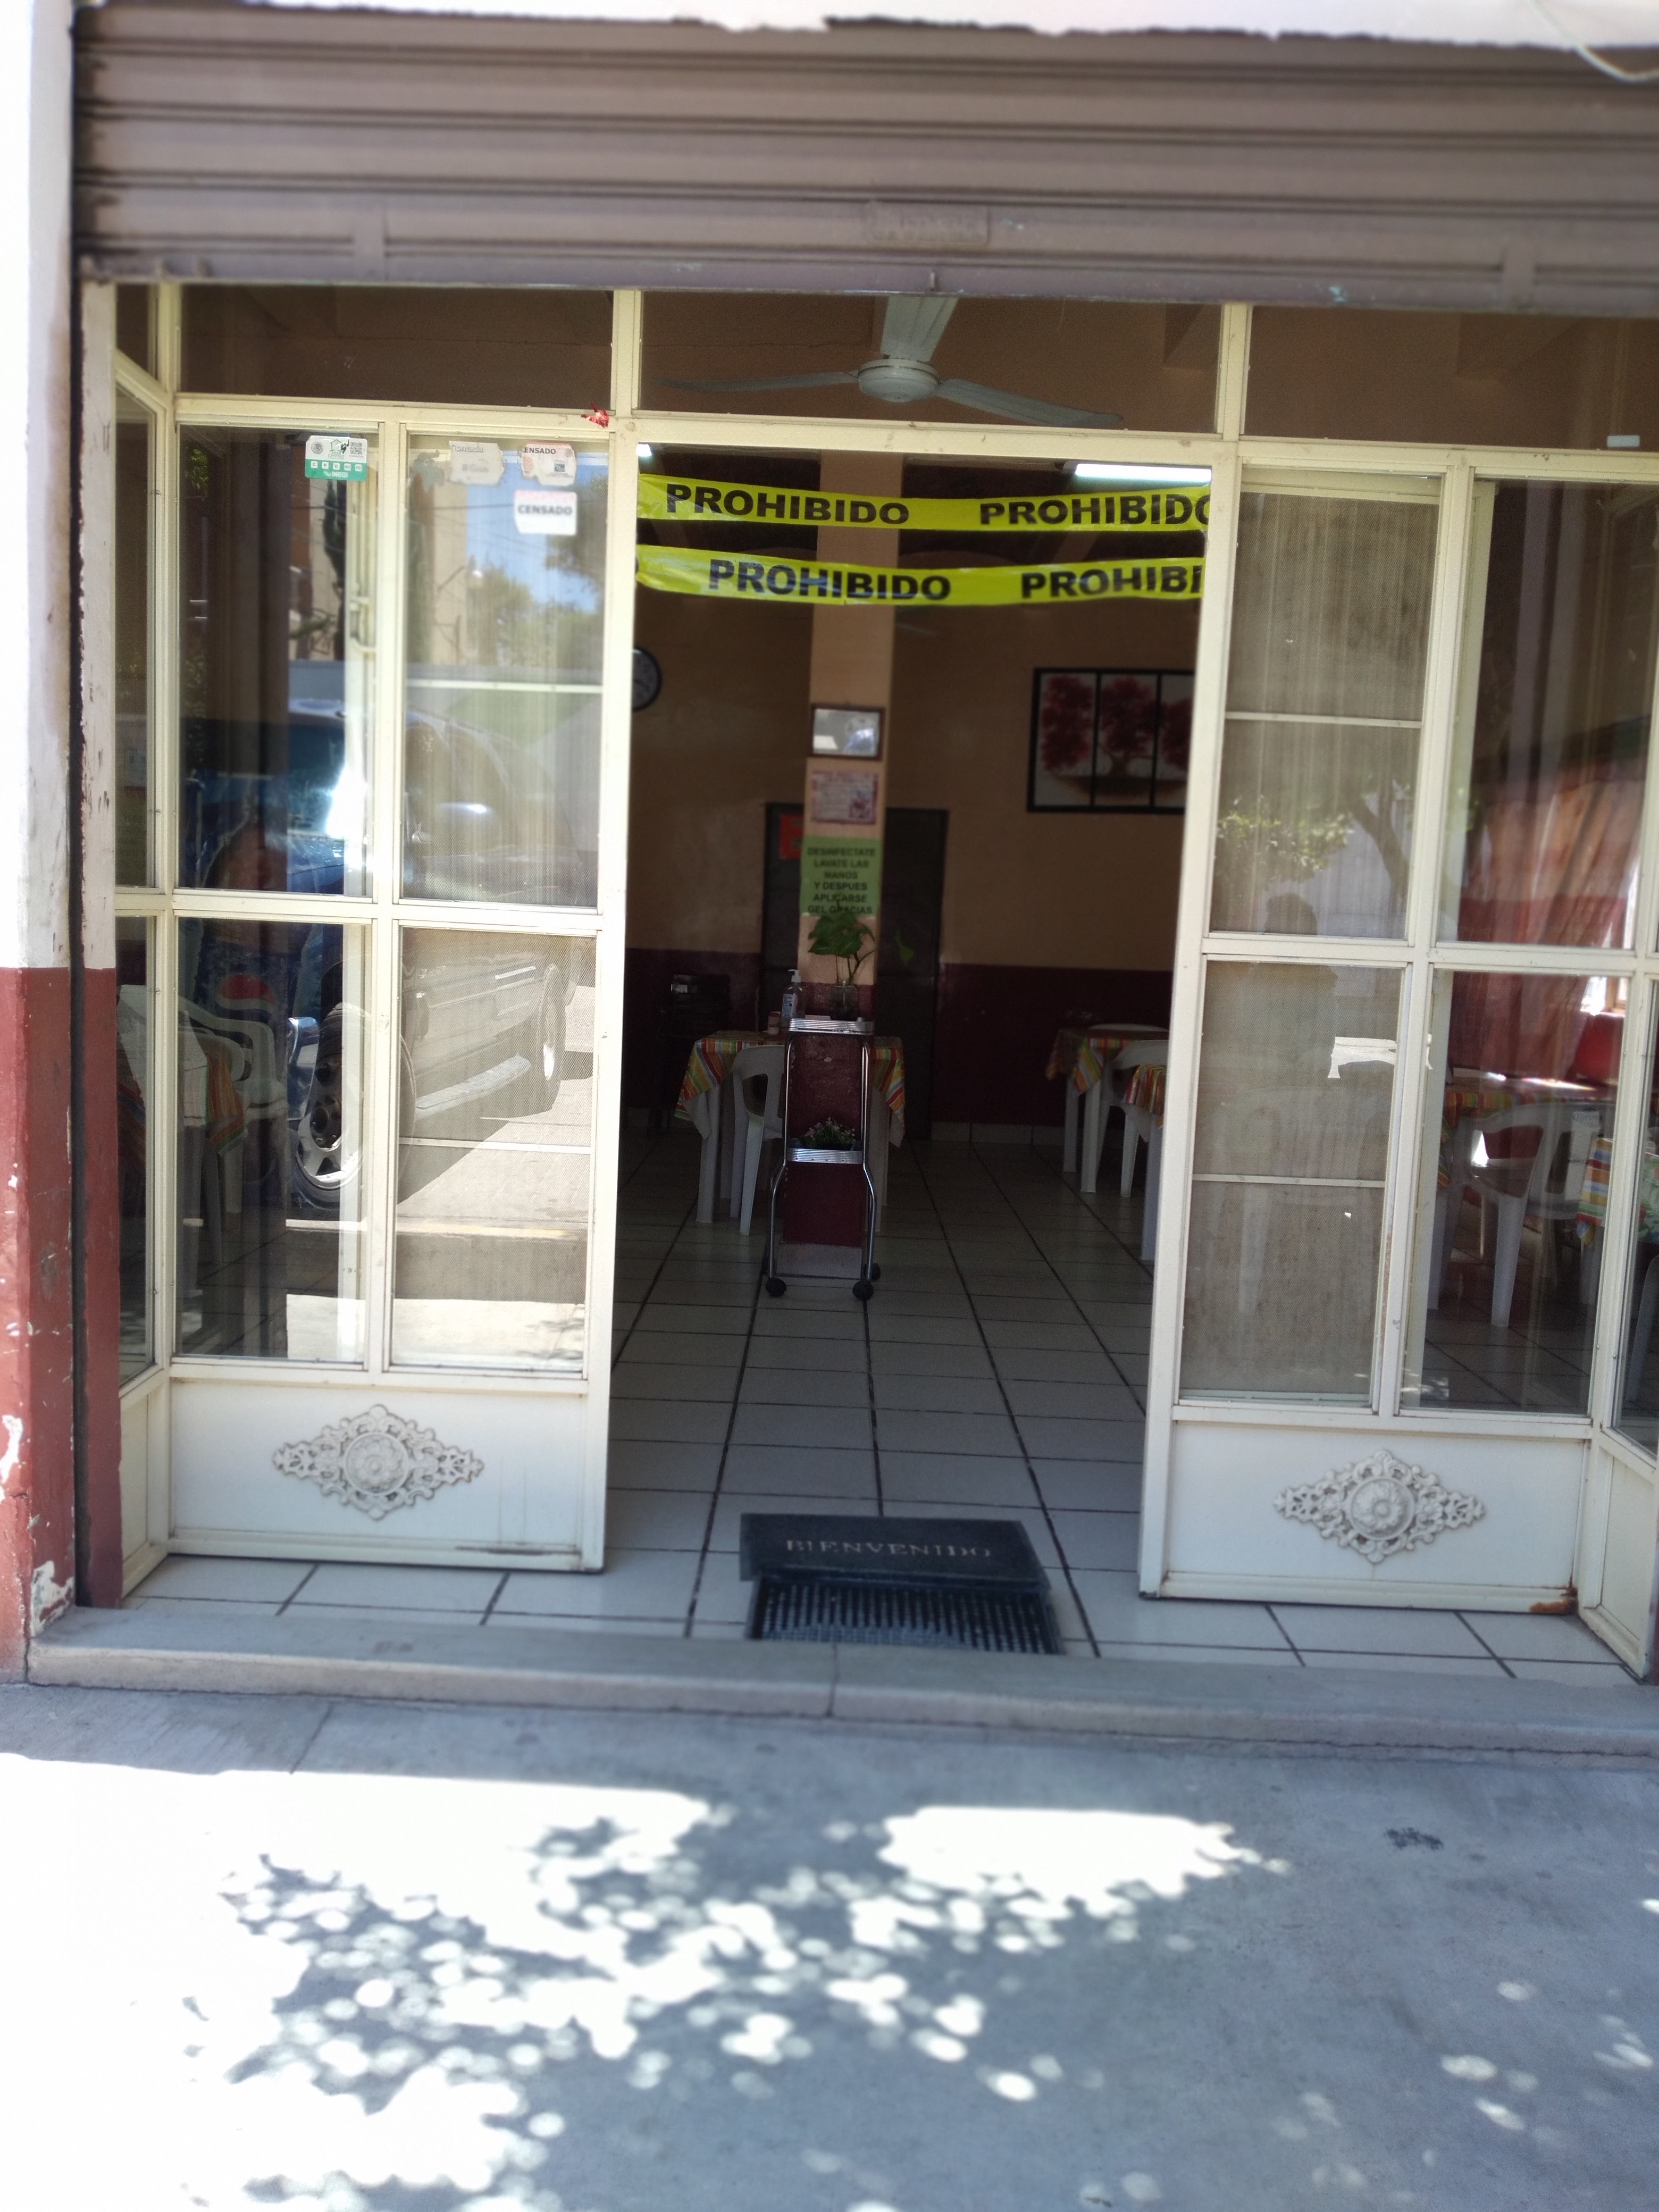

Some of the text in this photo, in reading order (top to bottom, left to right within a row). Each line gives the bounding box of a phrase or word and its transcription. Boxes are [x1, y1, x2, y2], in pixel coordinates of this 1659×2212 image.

[517, 505, 573, 515] CENSADO
[667, 483, 1211, 525] PROHIBIDO PROHIBIDO
[709, 559, 951, 600] PROHIBIDO
[823, 882, 867, 891] DESPUES
[813, 894, 867, 902] APLICARSE
[786, 1540, 991, 1556] BIENVENIDO
